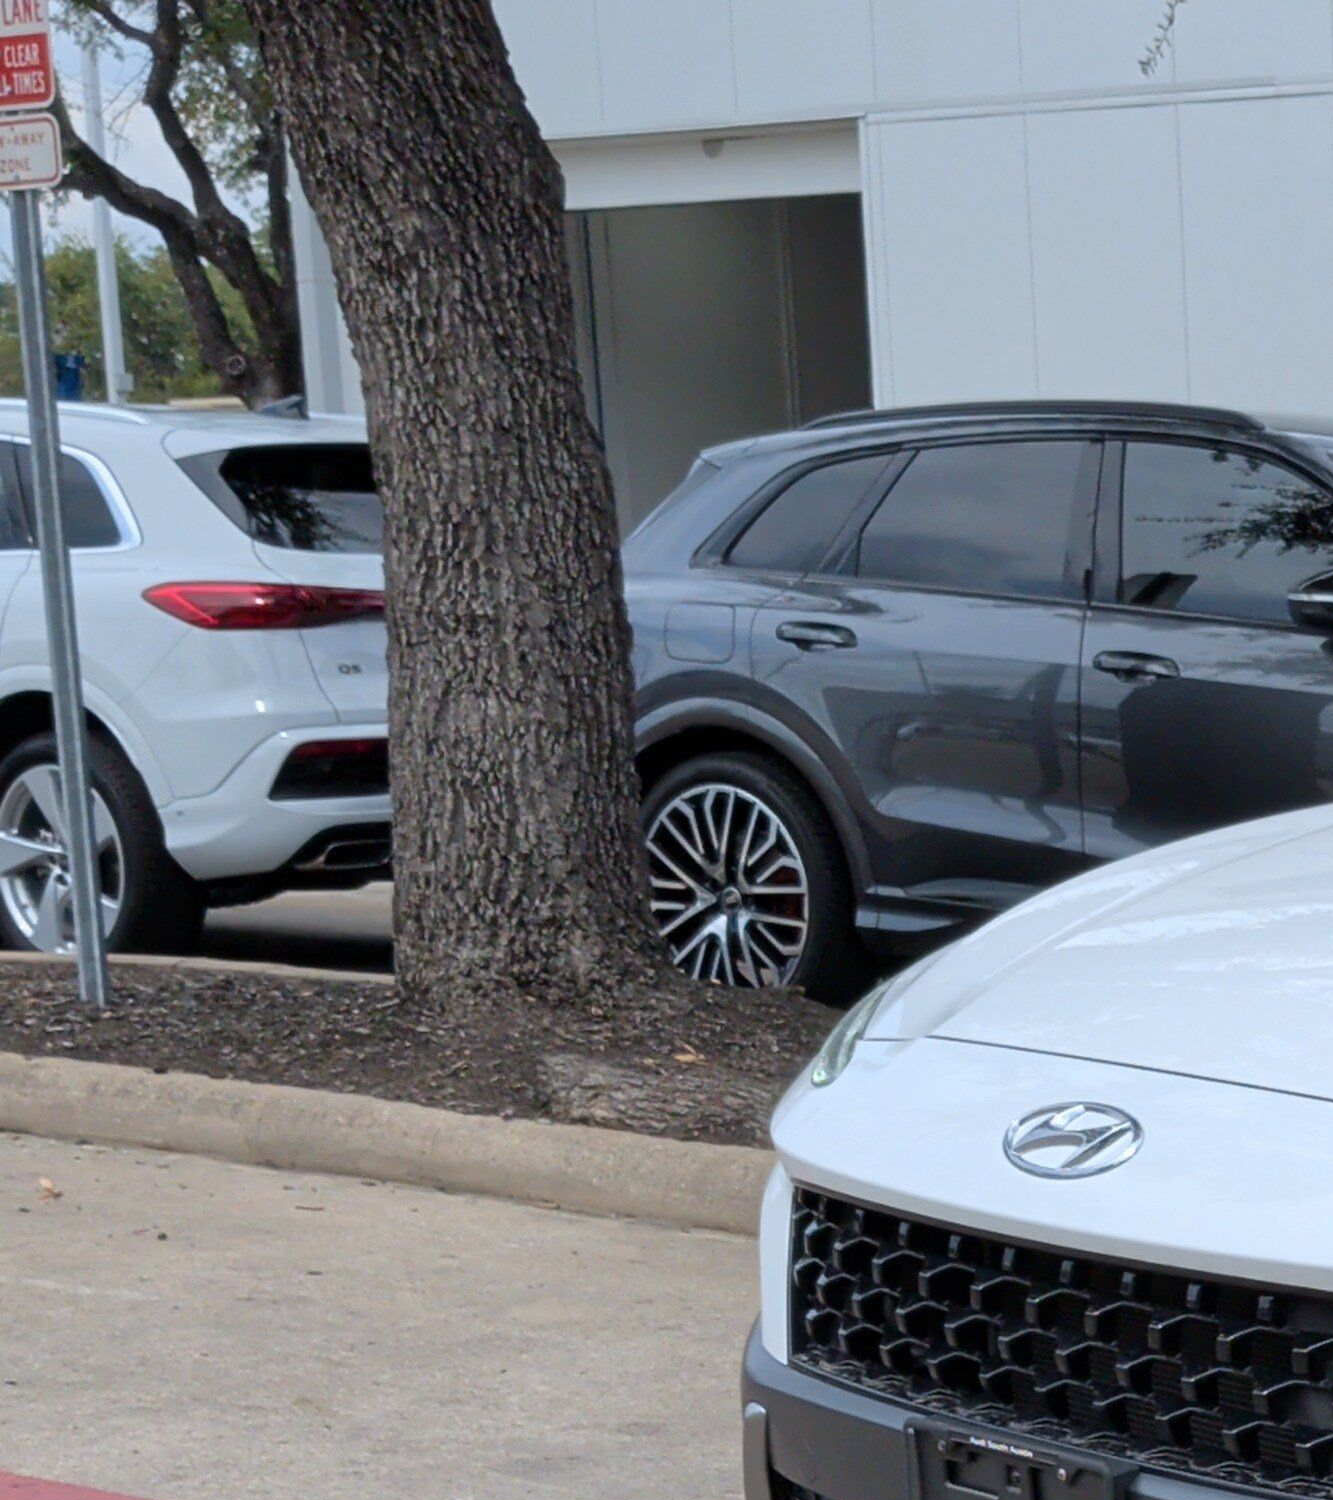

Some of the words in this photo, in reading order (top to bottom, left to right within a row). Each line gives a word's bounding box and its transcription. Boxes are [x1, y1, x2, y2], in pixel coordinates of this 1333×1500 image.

[3, 0, 43, 26] LANE
[4, 43, 40, 68] CLEAR
[12, 71, 46, 95] TIMES
[0, 157, 32, 174] ZONE
